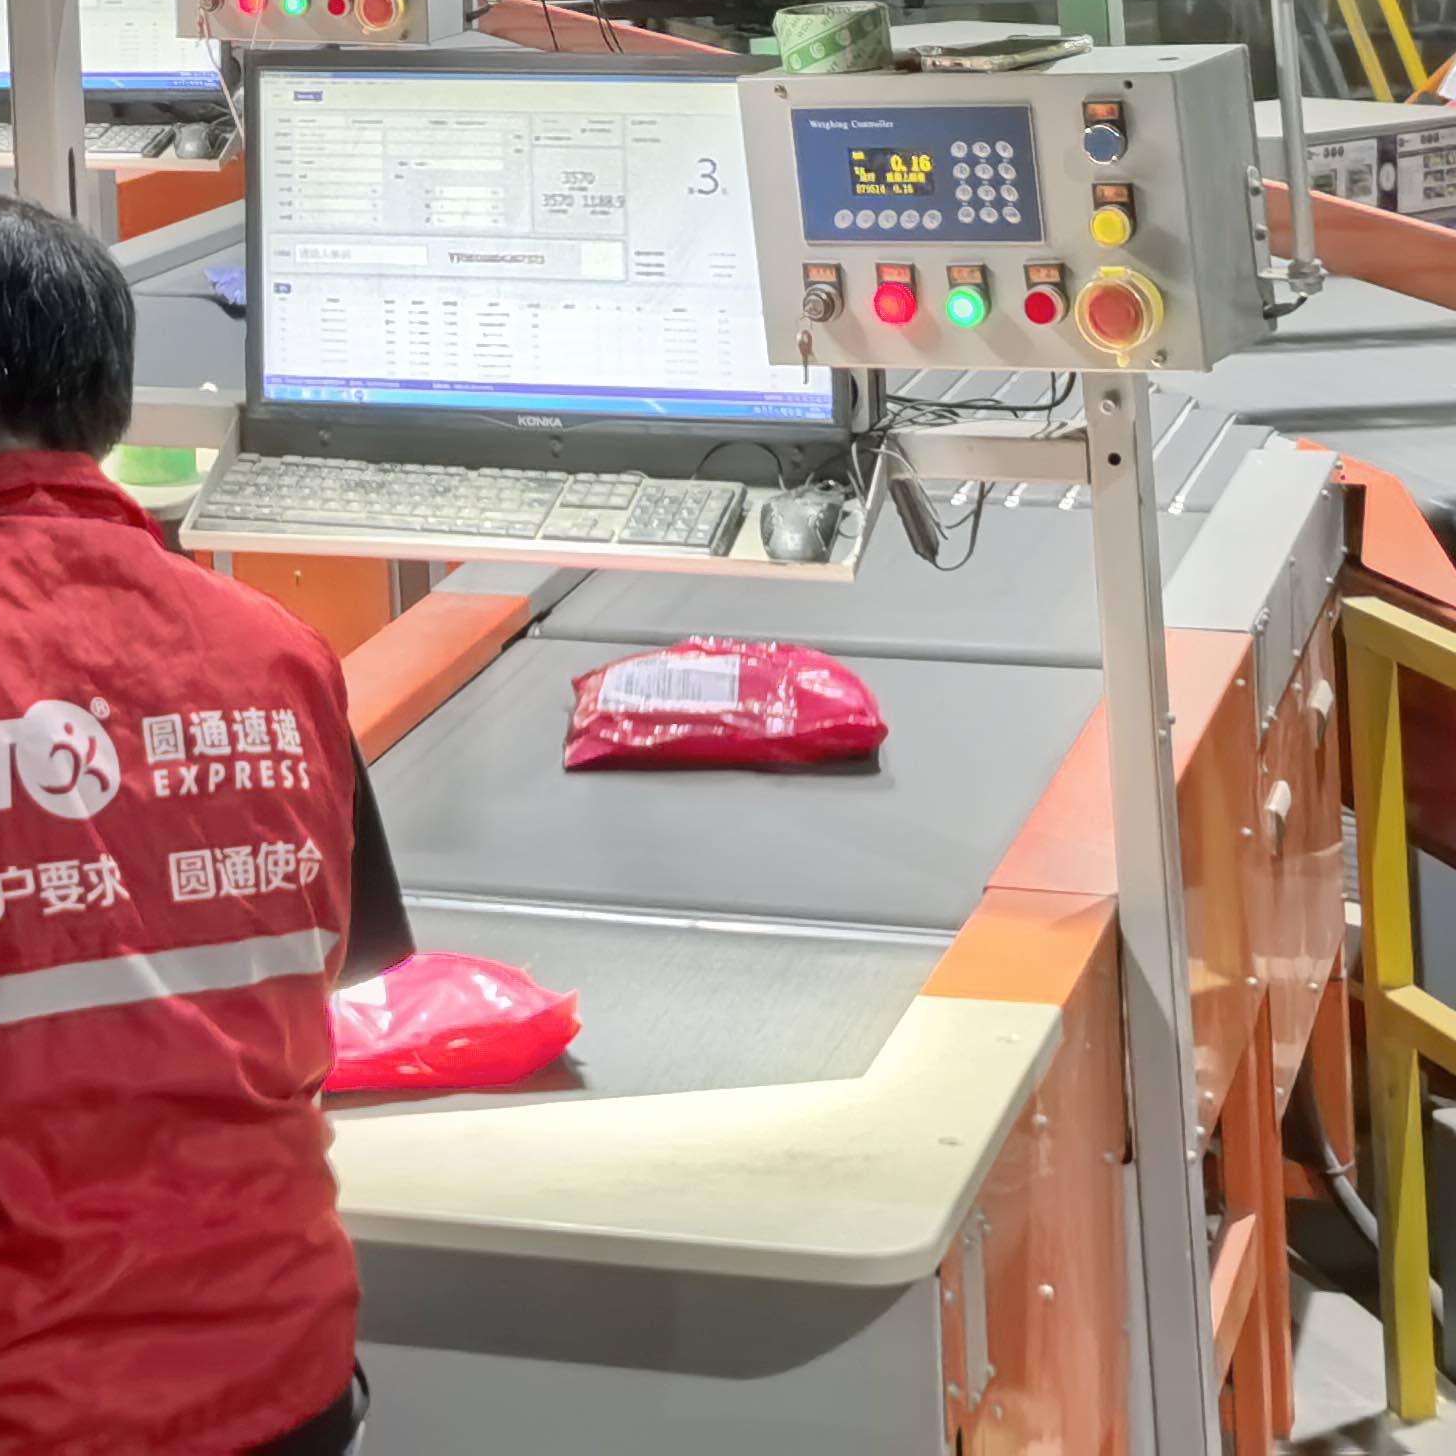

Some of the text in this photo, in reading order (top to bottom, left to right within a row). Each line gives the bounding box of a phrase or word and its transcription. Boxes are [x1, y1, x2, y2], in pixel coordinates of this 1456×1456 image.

[517, 415, 563, 428] KONKA
[141, 706, 304, 764] 圆通速递
[153, 759, 311, 798] EXPRESS
